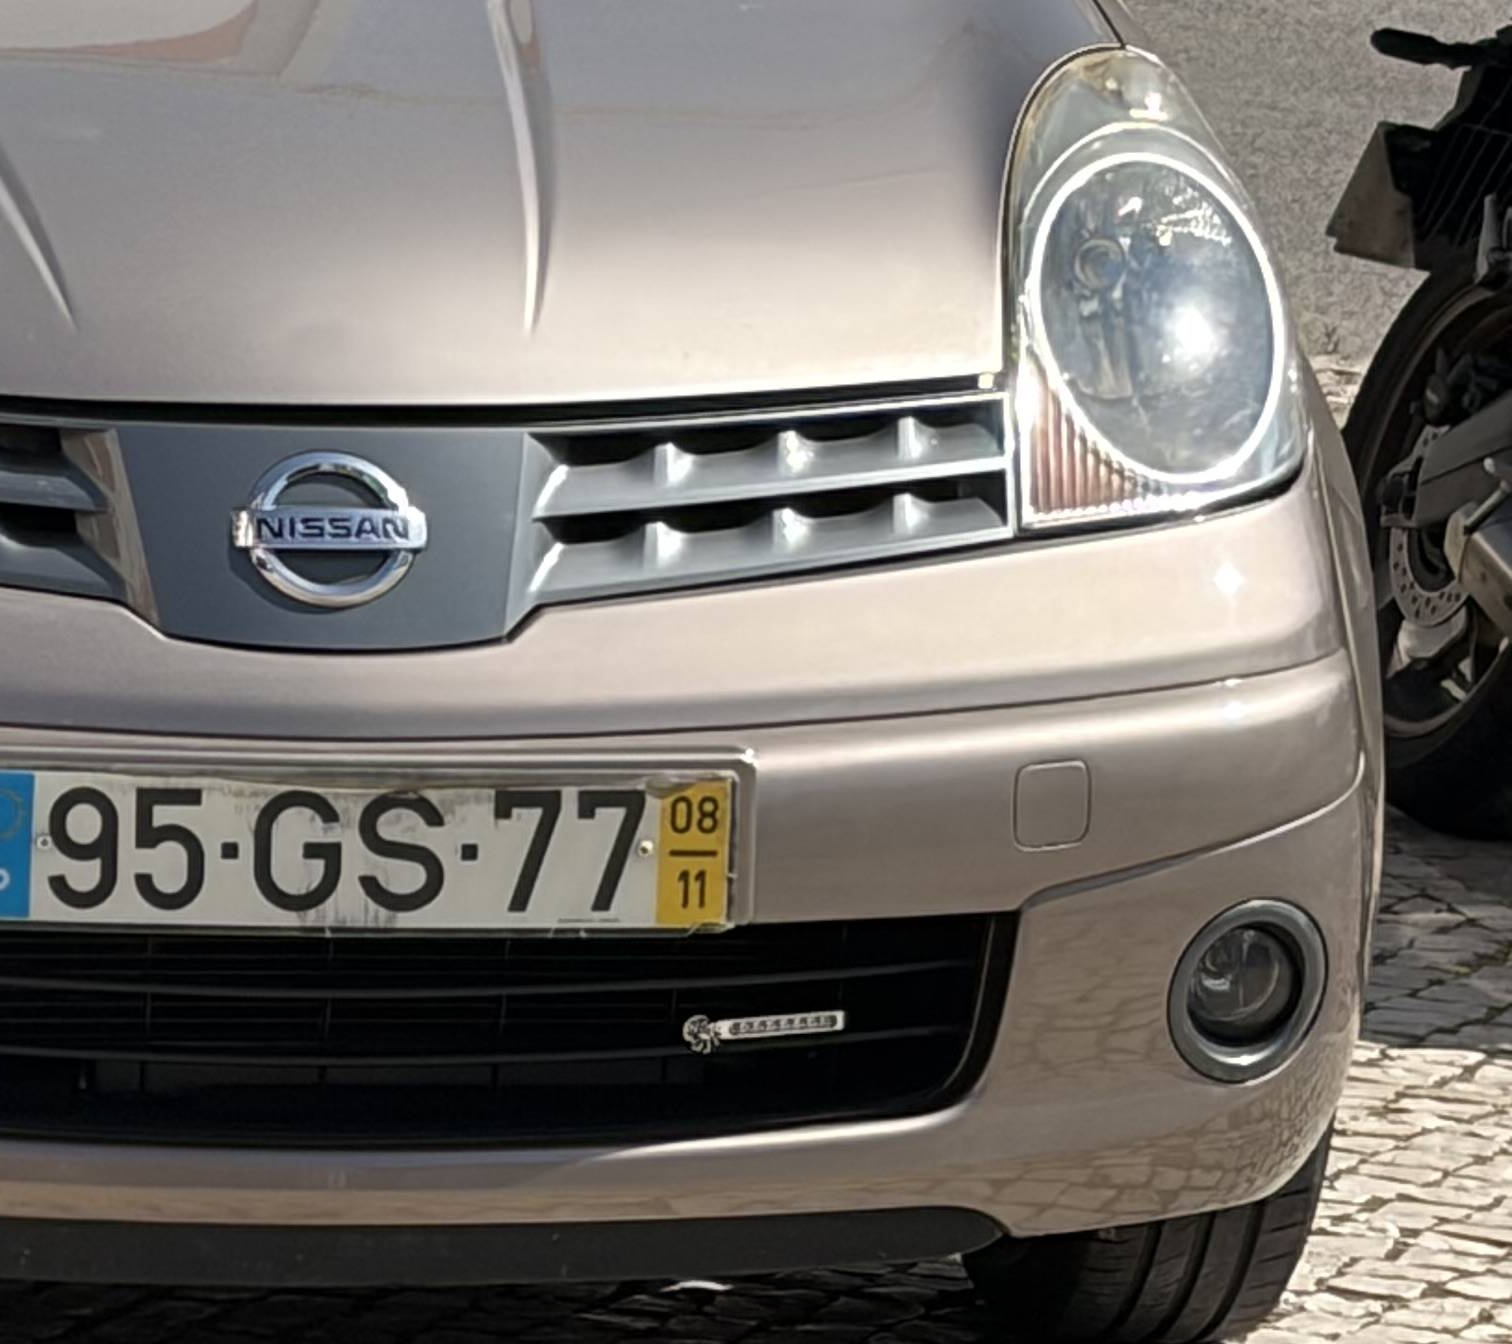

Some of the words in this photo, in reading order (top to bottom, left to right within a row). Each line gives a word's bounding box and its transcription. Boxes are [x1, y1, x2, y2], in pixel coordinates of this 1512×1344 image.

[256, 516, 410, 541] NISSAN
[670, 795, 719, 834] 08
[677, 869, 707, 909] 11
